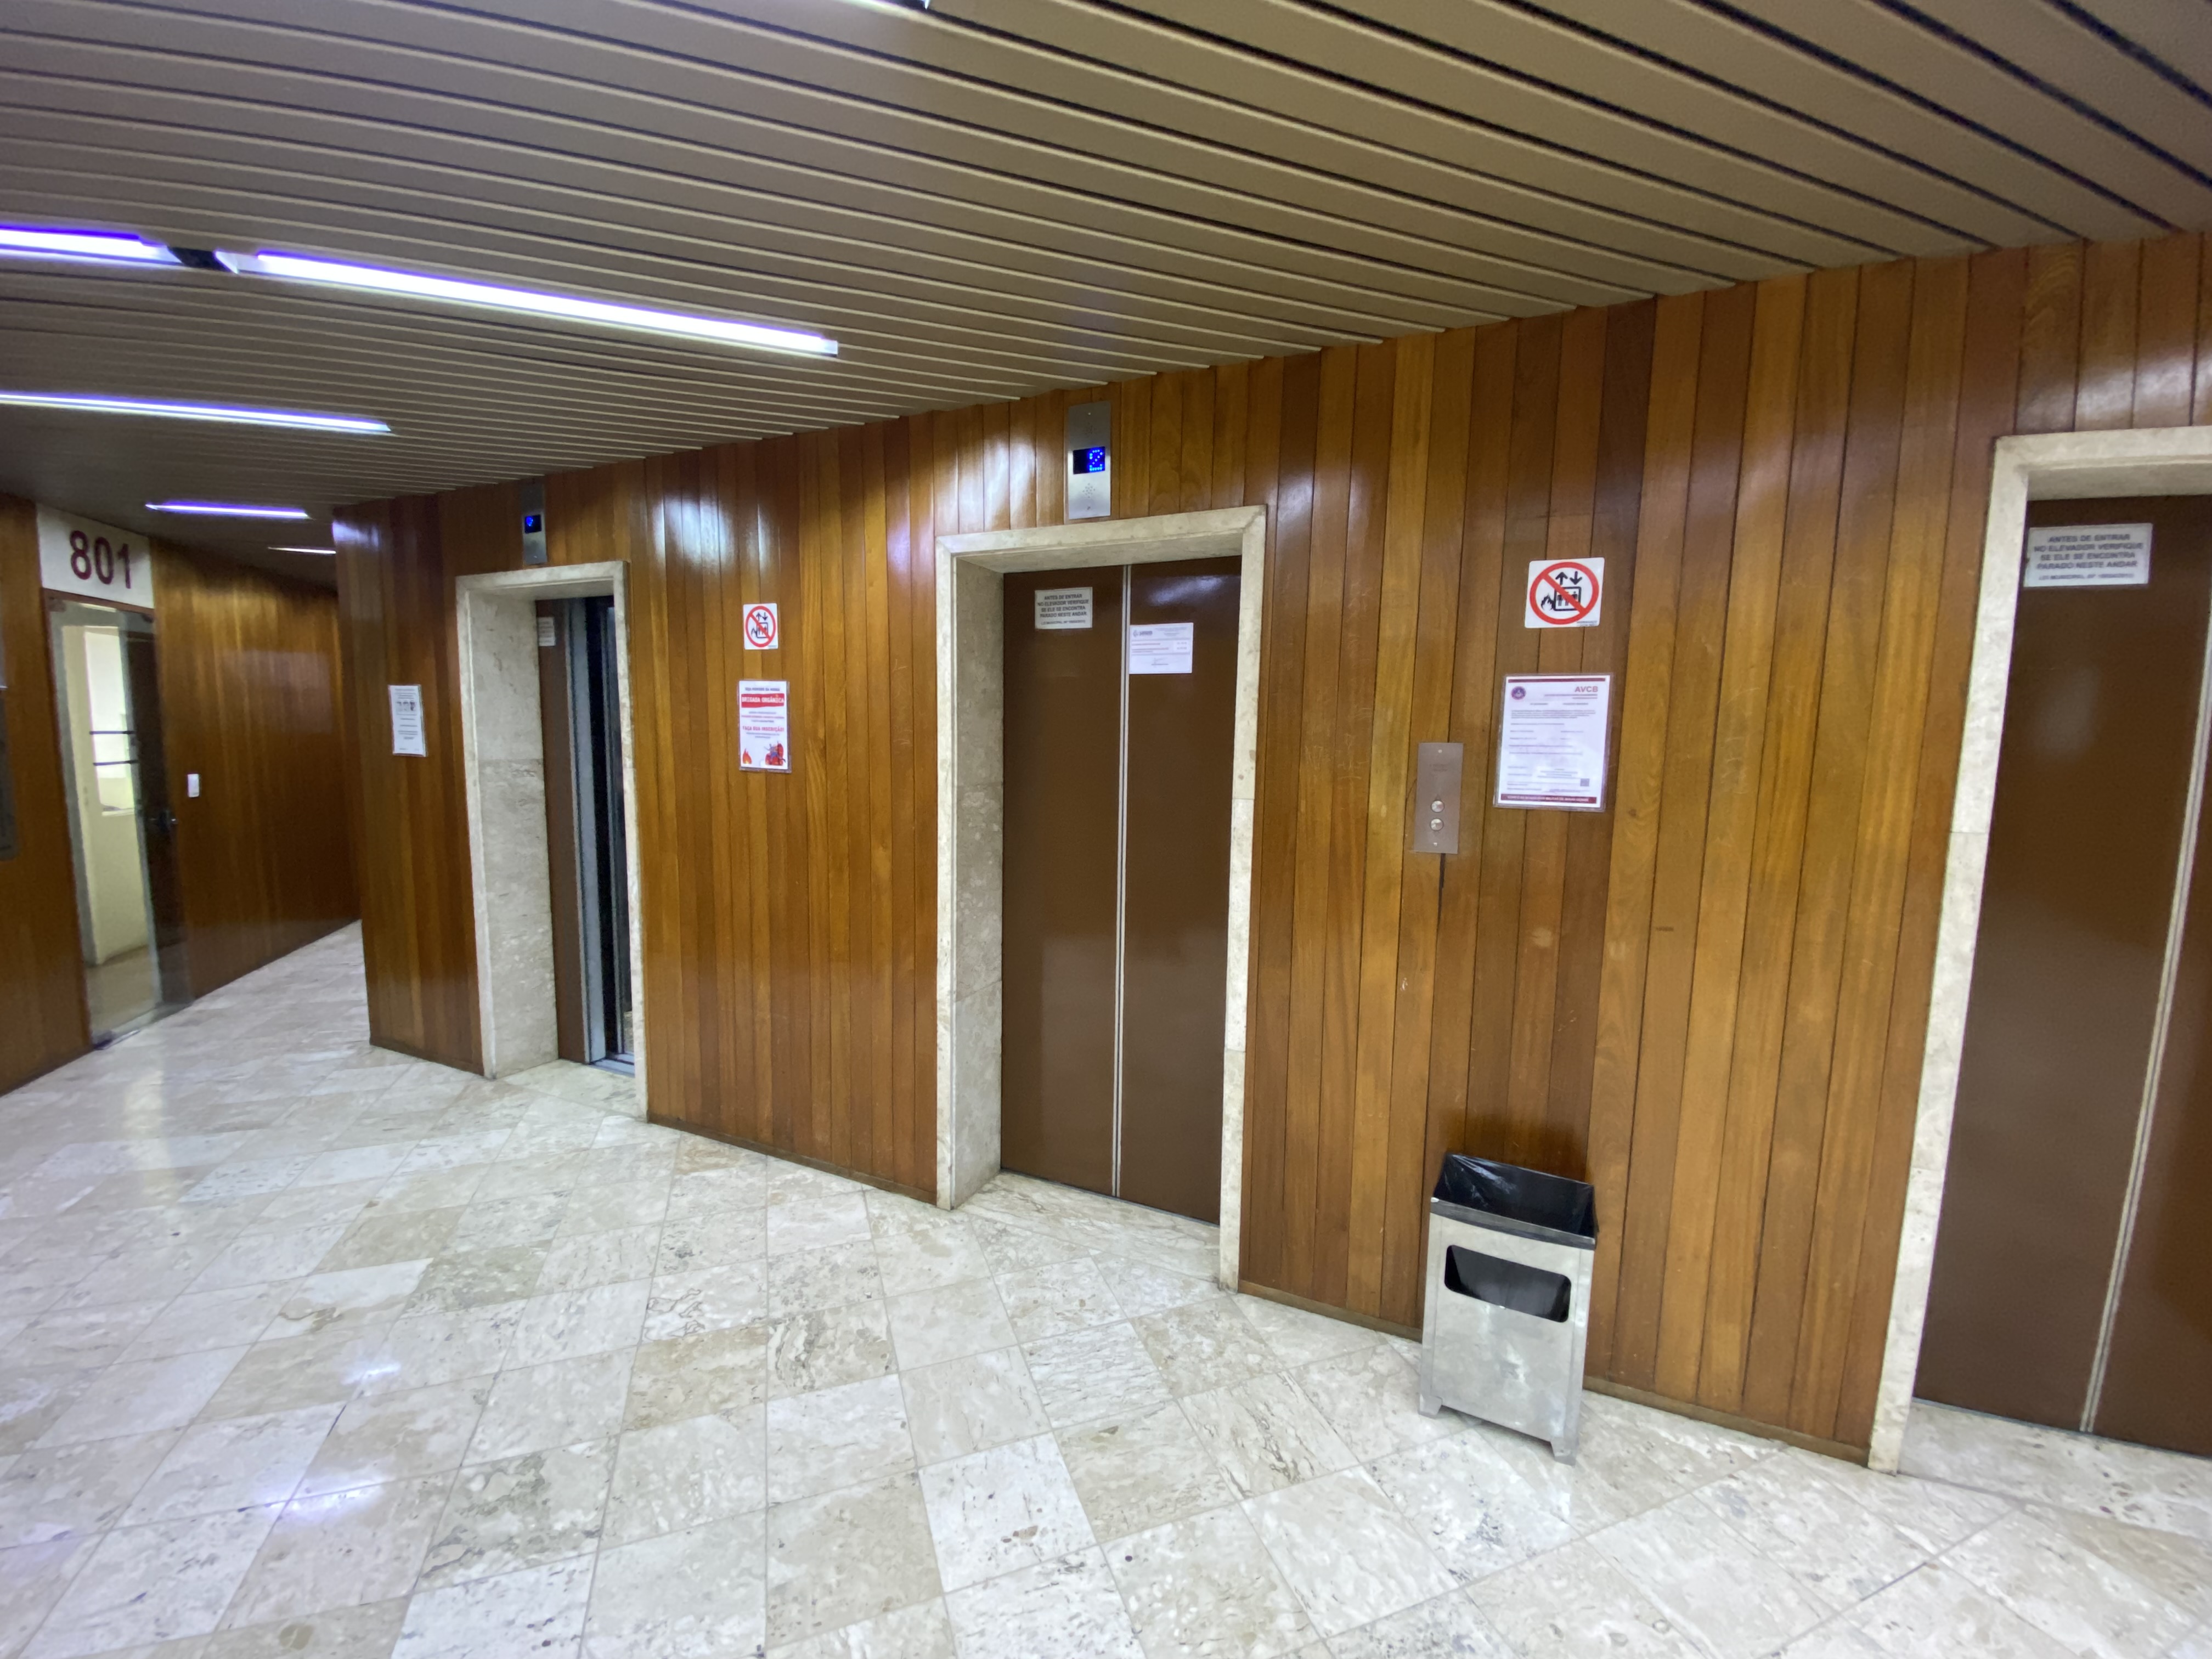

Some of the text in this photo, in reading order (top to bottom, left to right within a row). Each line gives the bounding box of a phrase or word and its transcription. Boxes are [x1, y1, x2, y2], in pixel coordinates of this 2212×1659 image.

[1089, 449, 1103, 471] 2
[2049, 543, 2095, 552] ELEVADOR
[2098, 542, 2143, 550] VERIFIQUE
[2087, 551, 2135, 559] ENCONTRA
[69, 530, 131, 589] 801
